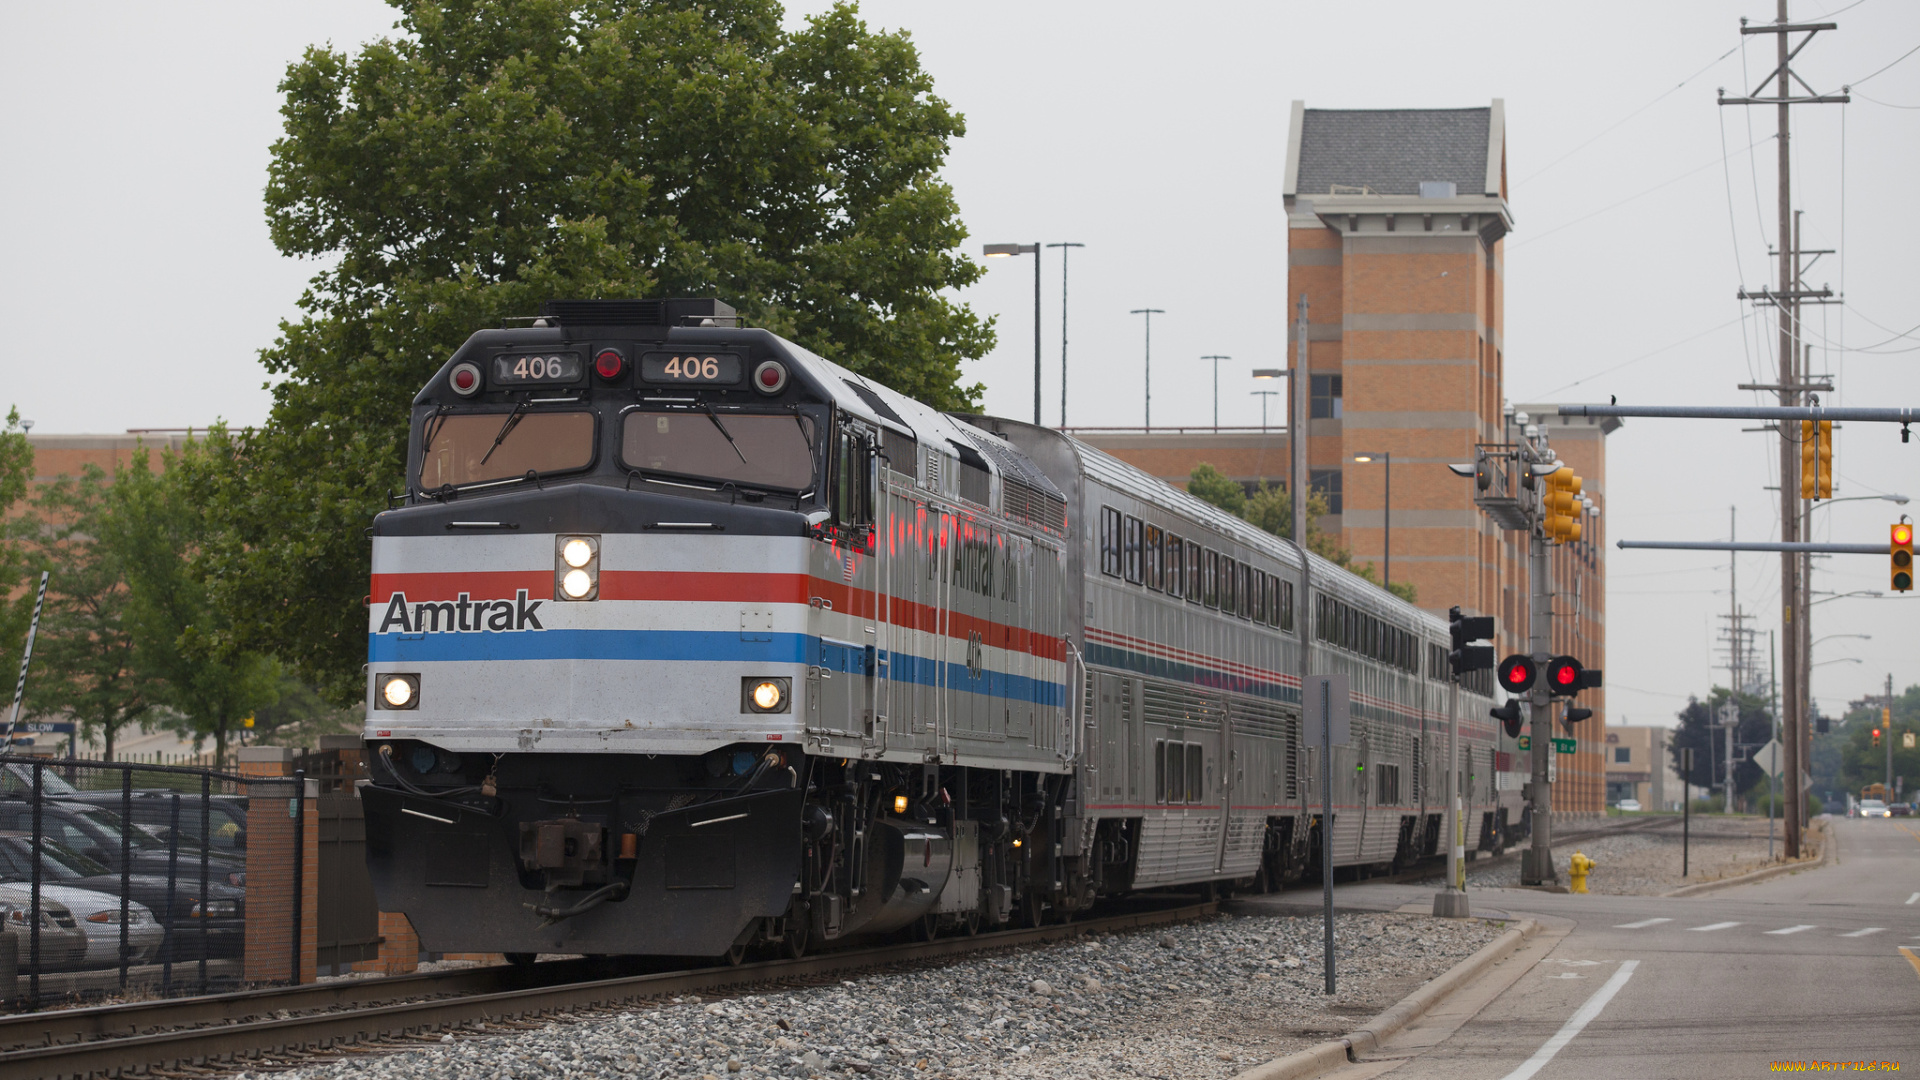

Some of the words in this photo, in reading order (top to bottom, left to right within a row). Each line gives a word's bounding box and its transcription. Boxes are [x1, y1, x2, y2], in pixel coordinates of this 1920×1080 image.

[513, 356, 562, 380] 406
[664, 356, 719, 379] 406
[952, 517, 996, 598] Amtrak
[377, 589, 547, 634] Amtrak
[966, 629, 982, 680] 406
[27, 723, 54, 732] SLOW
